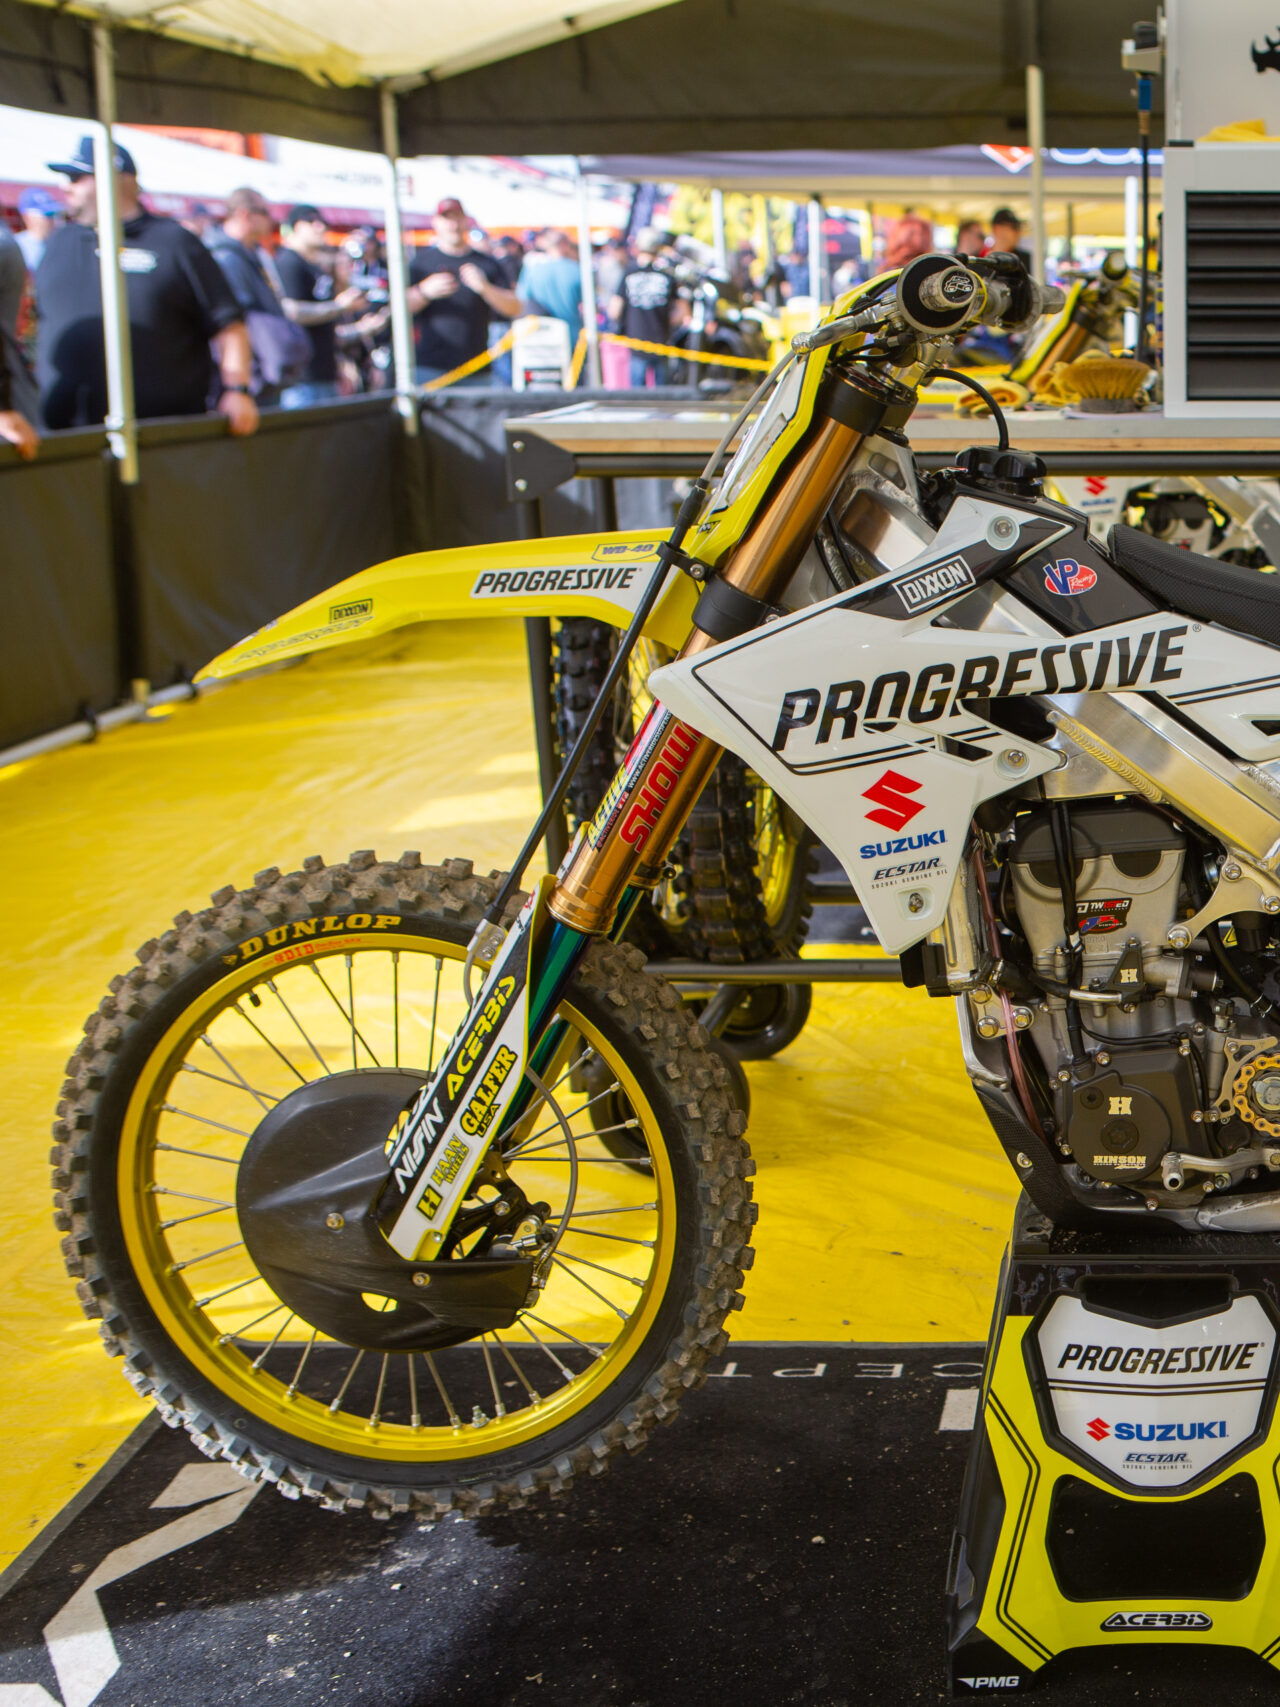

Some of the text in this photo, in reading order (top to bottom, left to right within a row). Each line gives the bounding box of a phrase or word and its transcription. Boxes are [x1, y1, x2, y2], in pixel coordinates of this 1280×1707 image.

[601, 543, 655, 555] WD-40
[474, 567, 637, 595] PROGRESSIVE
[903, 563, 970, 607] DIXXON
[1043, 558, 1079, 595] VP
[772, 625, 1188, 752] PROGRESSIVE
[860, 829, 947, 859] SUZUKI
[874, 857, 941, 880] ECSTAR
[238, 913, 402, 960] DUNLOP
[447, 975, 516, 1100] ACERBIS
[460, 1045, 517, 1135] GALFER
[477, 1103, 501, 1138] USA
[430, 1135, 461, 1187] HAAN
[445, 1144, 470, 1185] WHEELS
[1093, 1155, 1147, 1164] HINSON
[1058, 1343, 1260, 1374] PROGRESSIVE
[1114, 1420, 1227, 1441] SUZUKI
[1125, 1453, 1187, 1463] ECSTAR
[1105, 1612, 1212, 1627] ACERBIS
[975, 1675, 1020, 1689] PMG
